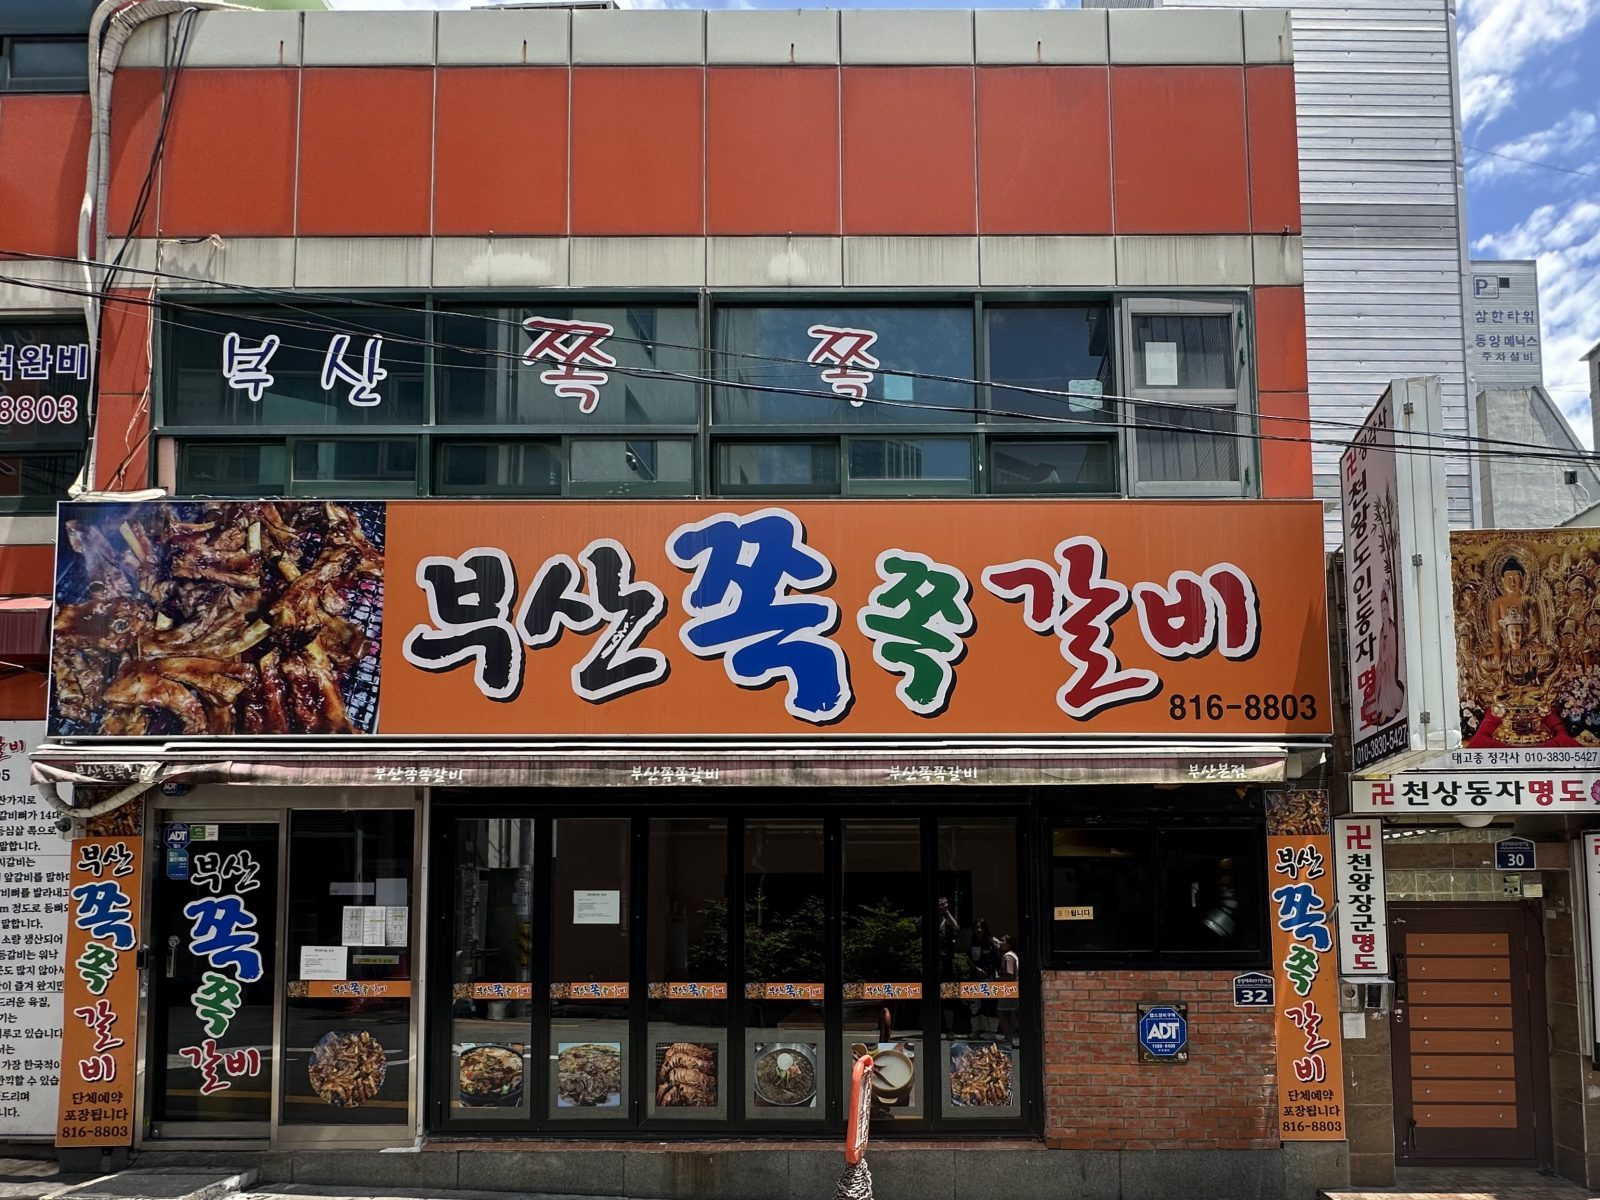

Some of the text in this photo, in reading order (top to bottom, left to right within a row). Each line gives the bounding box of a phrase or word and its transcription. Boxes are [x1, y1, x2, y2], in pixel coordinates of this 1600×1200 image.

[1475, 310, 1534, 323] 삼한타워
[1481, 351, 1533, 362] 주차설비
[1170, 694, 1317, 721] 816-8803
[1356, 724, 1408, 764] 010-3830-5427
[1452, 752, 1598, 764] 태고종 정각사 010-3830-5427
[374, 766, 463, 782] 부산쪽쪽갈비
[631, 766, 720, 783] 부산쪽쪽갈비
[889, 765, 978, 781] 부산쪽쪽갈비
[168, 831, 187, 841] ADT
[0, 841, 40, 851] 말합니다.
[77, 842, 134, 877] 부산
[1275, 844, 1325, 879] 부산
[1507, 853, 1525, 866] 30
[191, 850, 260, 893] 부산
[0, 888, 30, 898] 비뼈를
[12, 903, 41, 914] 정도로
[1, 919, 43, 930] 말합니다.
[1, 934, 63, 945] 소량 생산되어
[38, 950, 59, 960] 워낙
[16, 965, 35, 975] 많지
[0, 980, 11, 991] 이
[15, 980, 33, 991] 즐겨
[1241, 990, 1268, 1003] 32
[0, 1028, 22, 1038] 루고
[1147, 1022, 1179, 1040] ADT
[2, 1059, 21, 1070] 가장
[179, 1039, 261, 1095] 갈비
[27, 1075, 37, 1086] 수
[0, 1091, 29, 1101] 드리며
[72, 1091, 124, 1104] 단체예약
[1288, 1089, 1334, 1101] 단체예약
[64, 1108, 128, 1120] 포장됩니다
[1283, 1105, 1340, 1117] 포장됩니다
[62, 1126, 128, 1138] 816-8803
[1283, 1121, 1342, 1132] 816-8803
